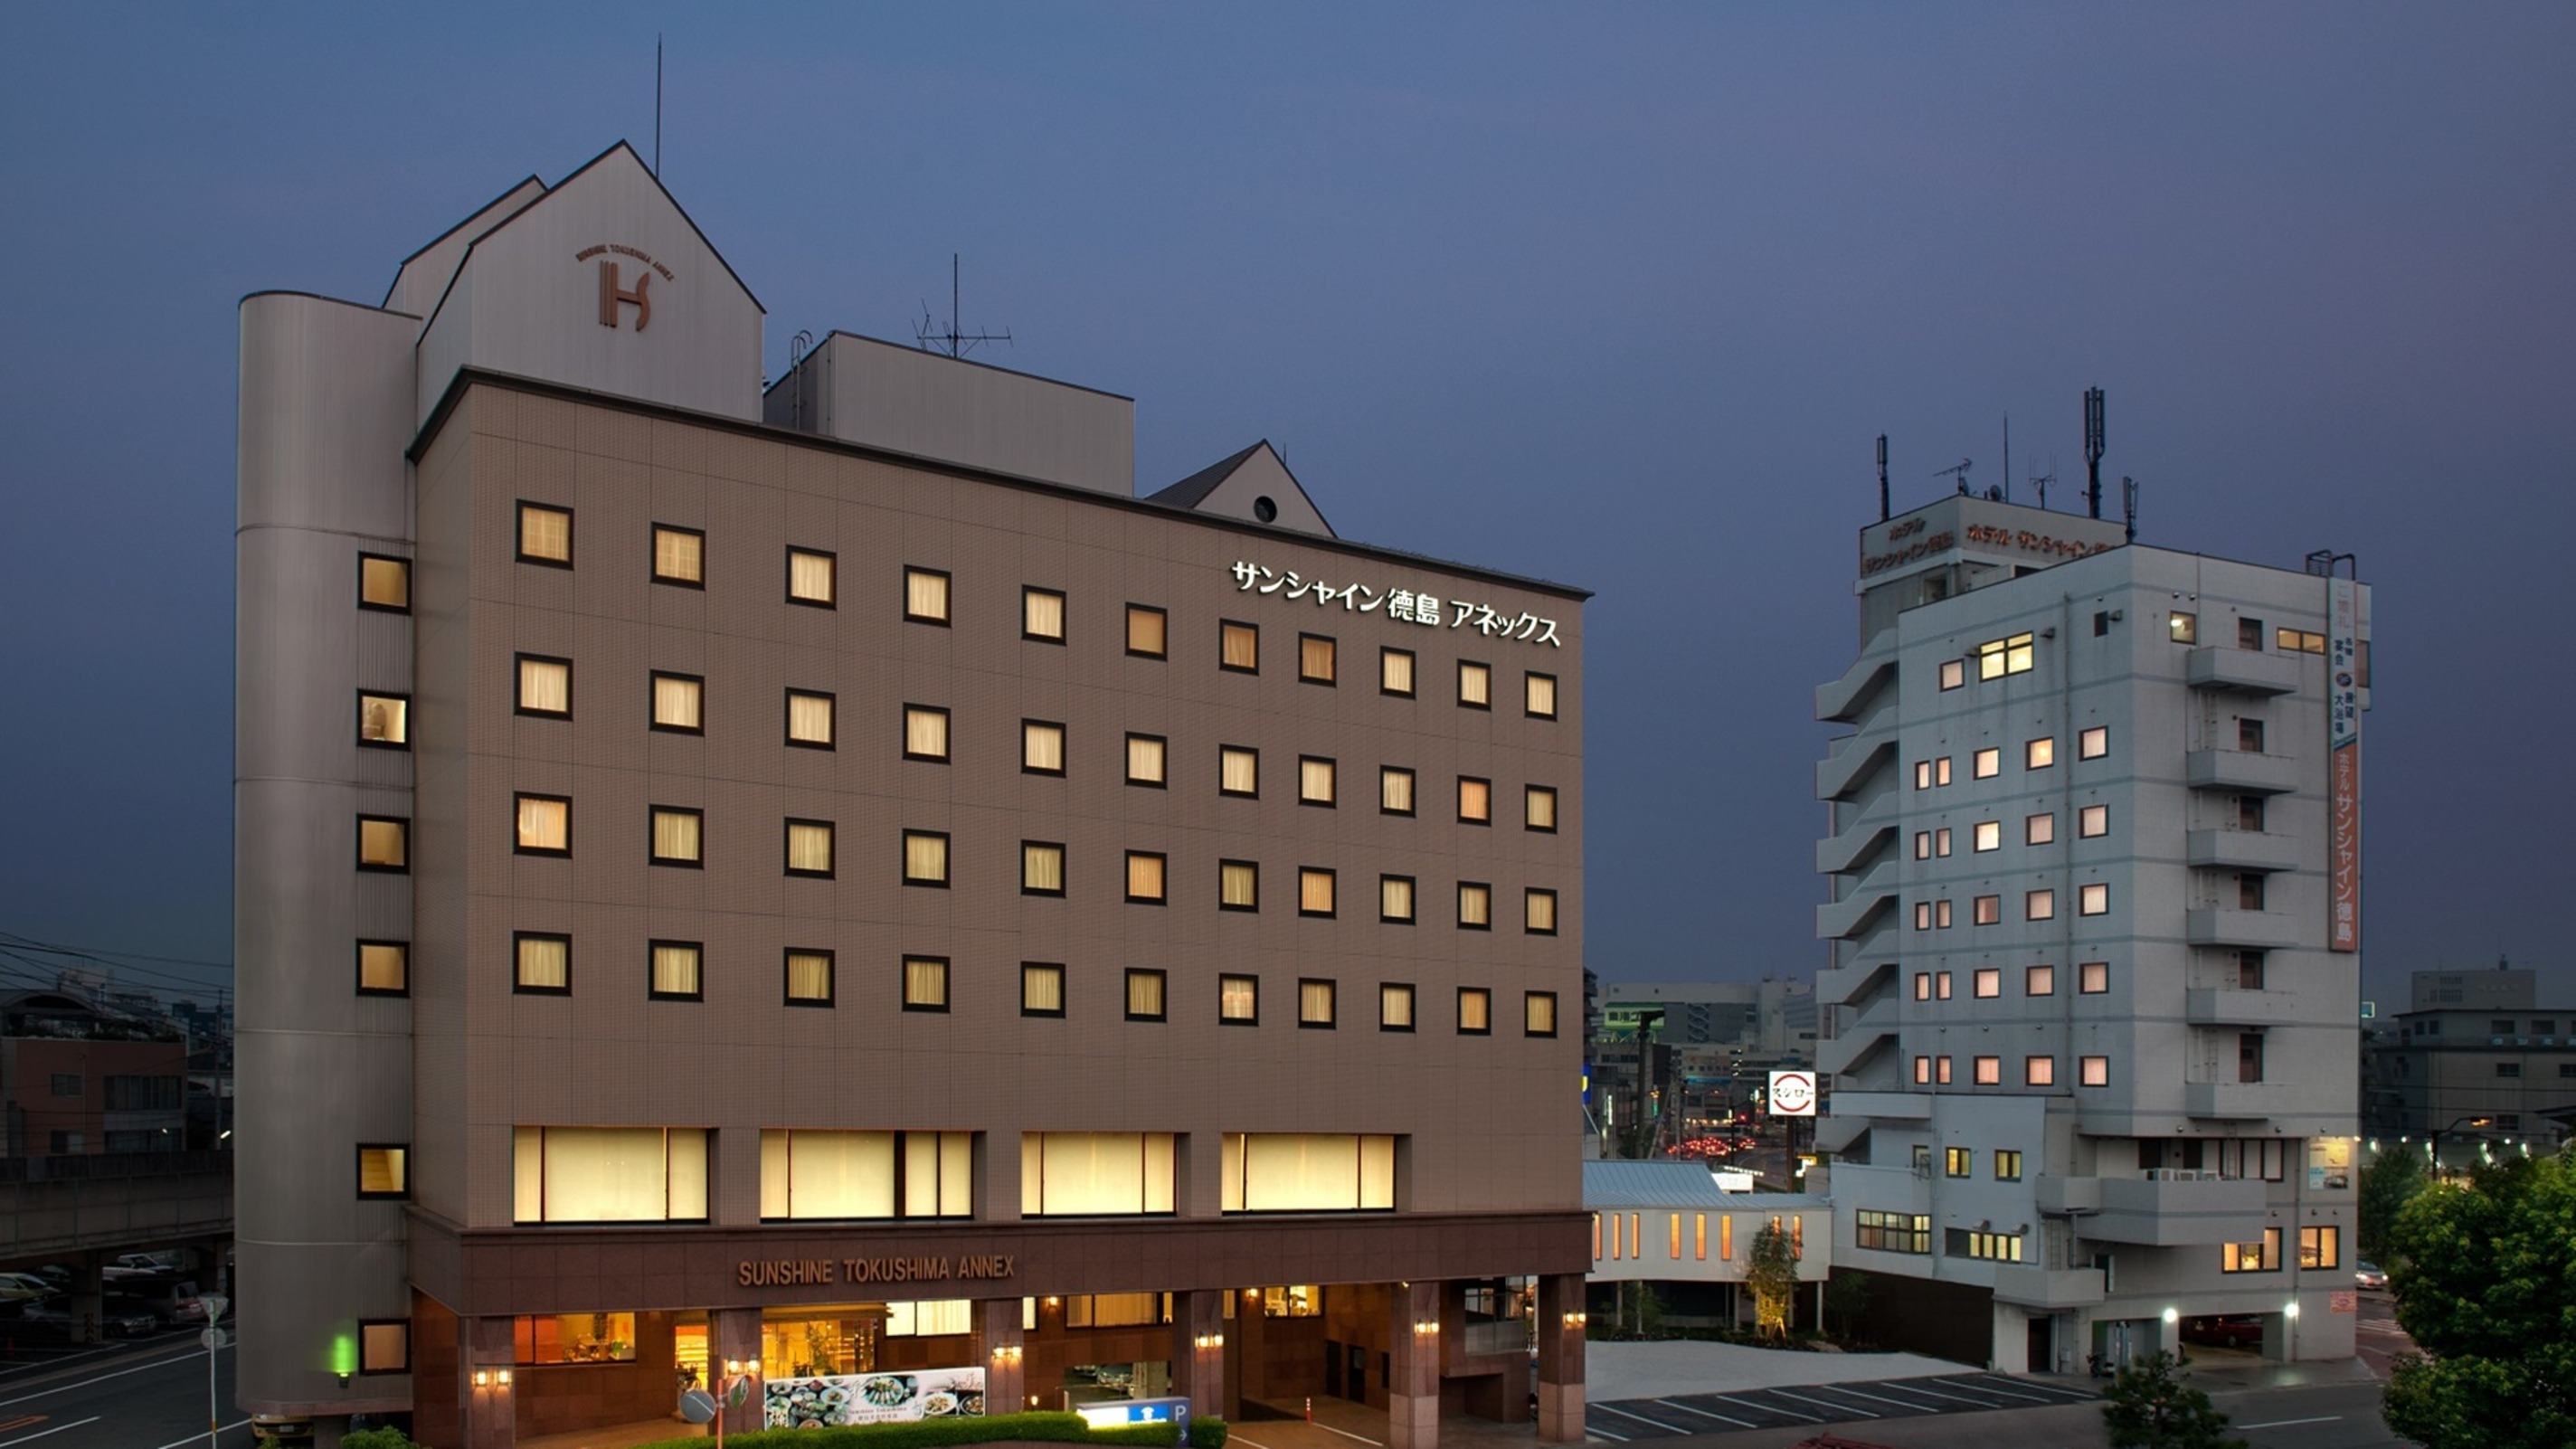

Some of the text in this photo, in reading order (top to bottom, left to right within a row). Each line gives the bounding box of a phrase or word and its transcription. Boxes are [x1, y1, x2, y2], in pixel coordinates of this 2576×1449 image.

[1967, 524, 2012, 545] ホテル
[1448, 599, 1562, 648] アネックス
[1773, 1087, 1814, 1098] スシロー
[737, 1255, 1015, 1287] SUNSHINE TOKUSHIMA ANNEX
[1174, 1405, 1187, 1421] P
